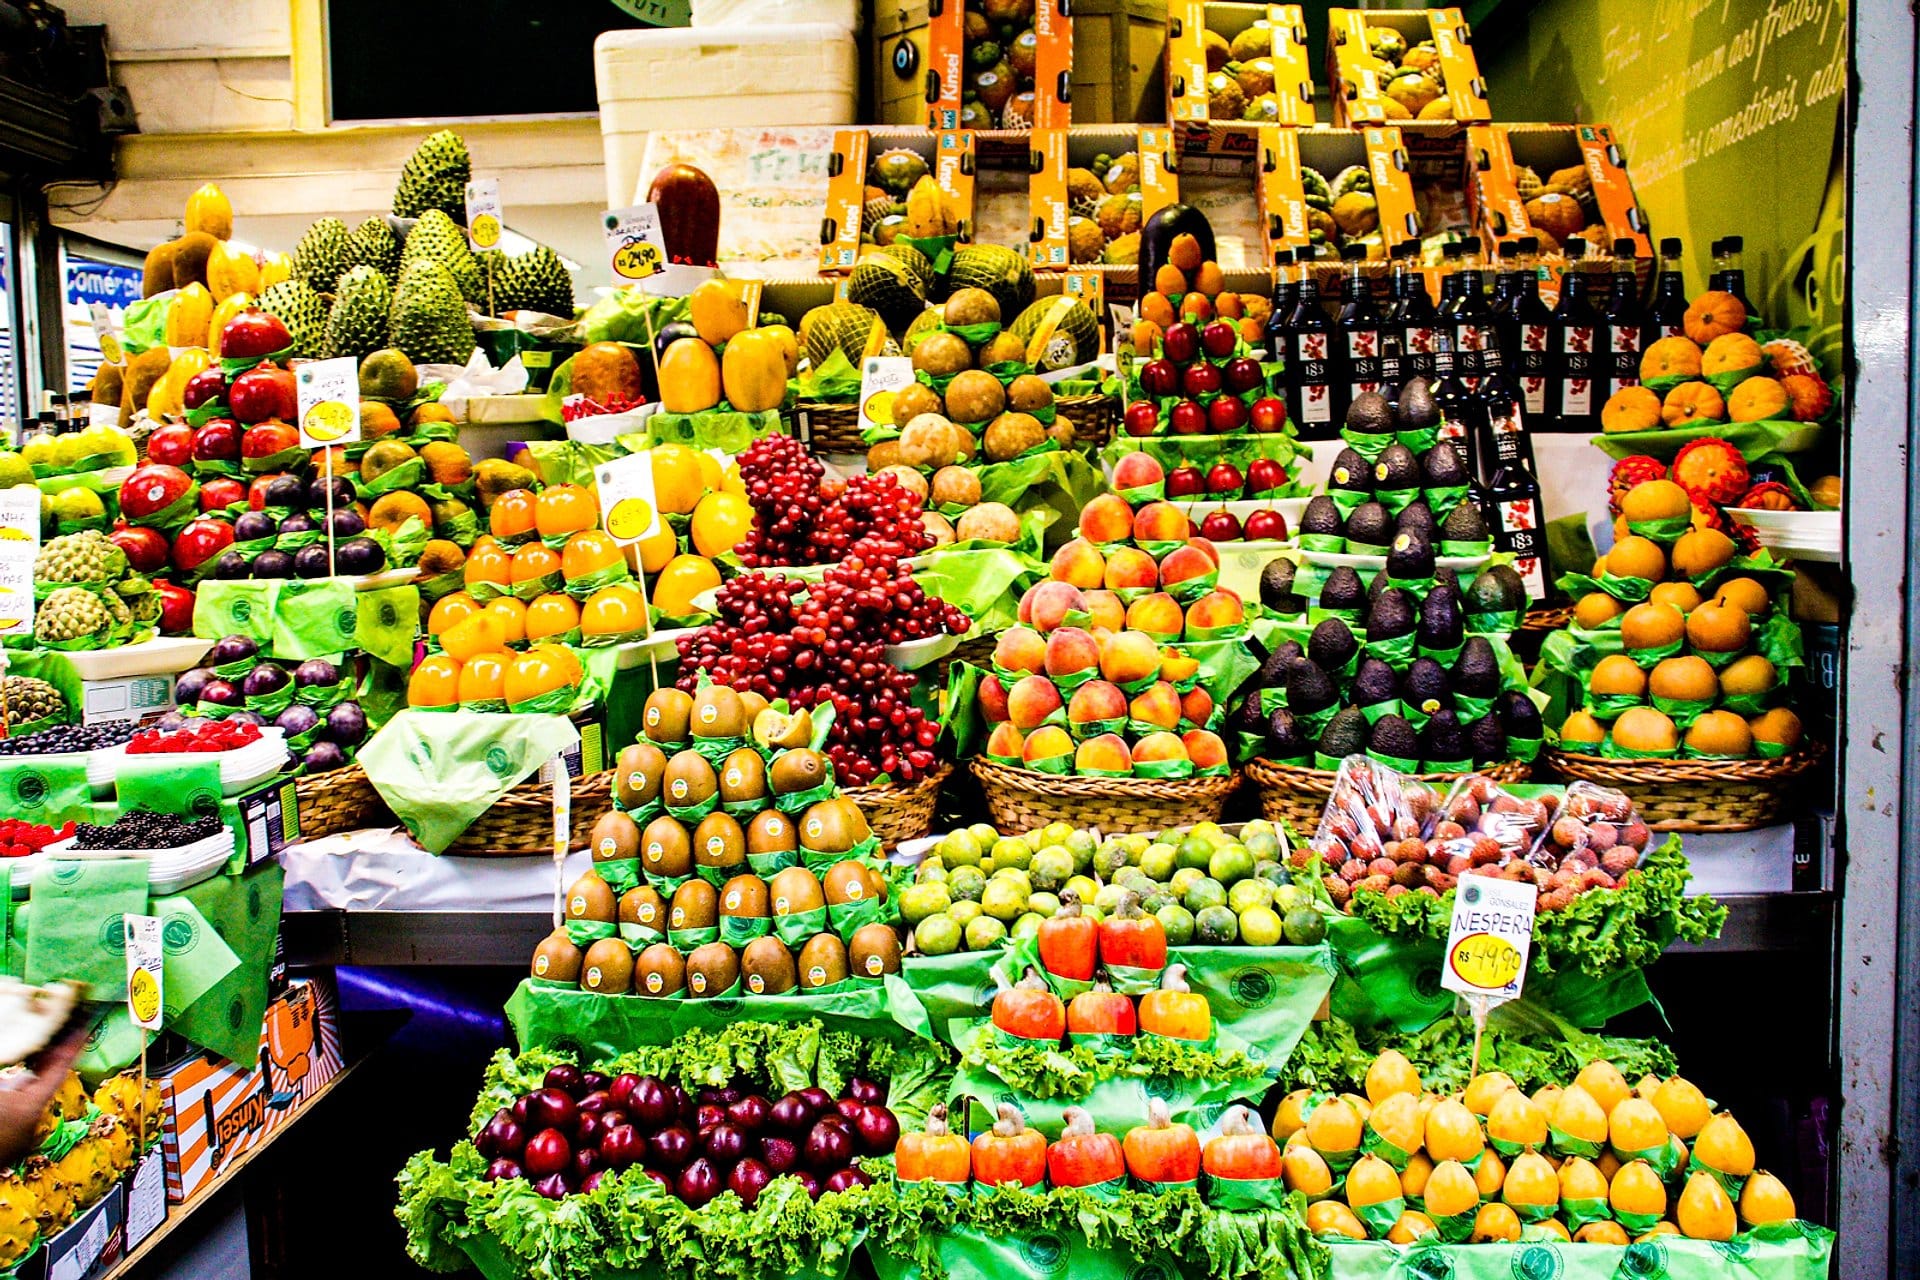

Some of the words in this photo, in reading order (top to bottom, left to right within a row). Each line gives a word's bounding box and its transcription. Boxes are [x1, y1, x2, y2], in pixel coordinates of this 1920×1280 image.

[1039, 0, 1054, 36] insei
[941, 53, 960, 100] Kinsei
[939, 154, 958, 193] Kinsei
[1143, 151, 1162, 187] Kinsei
[1370, 151, 1391, 187] Kinsei
[1586, 147, 1611, 183] Kinsei
[839, 203, 860, 242] Kinsei
[1046, 200, 1065, 240] Kinsei
[1285, 198, 1304, 237] Kinsei
[1504, 198, 1529, 235] Kinsei
[1455, 909, 1533, 935] NESPERA
[1473, 941, 1522, 979] 49,90
[218, 1092, 266, 1153] Kinsei
